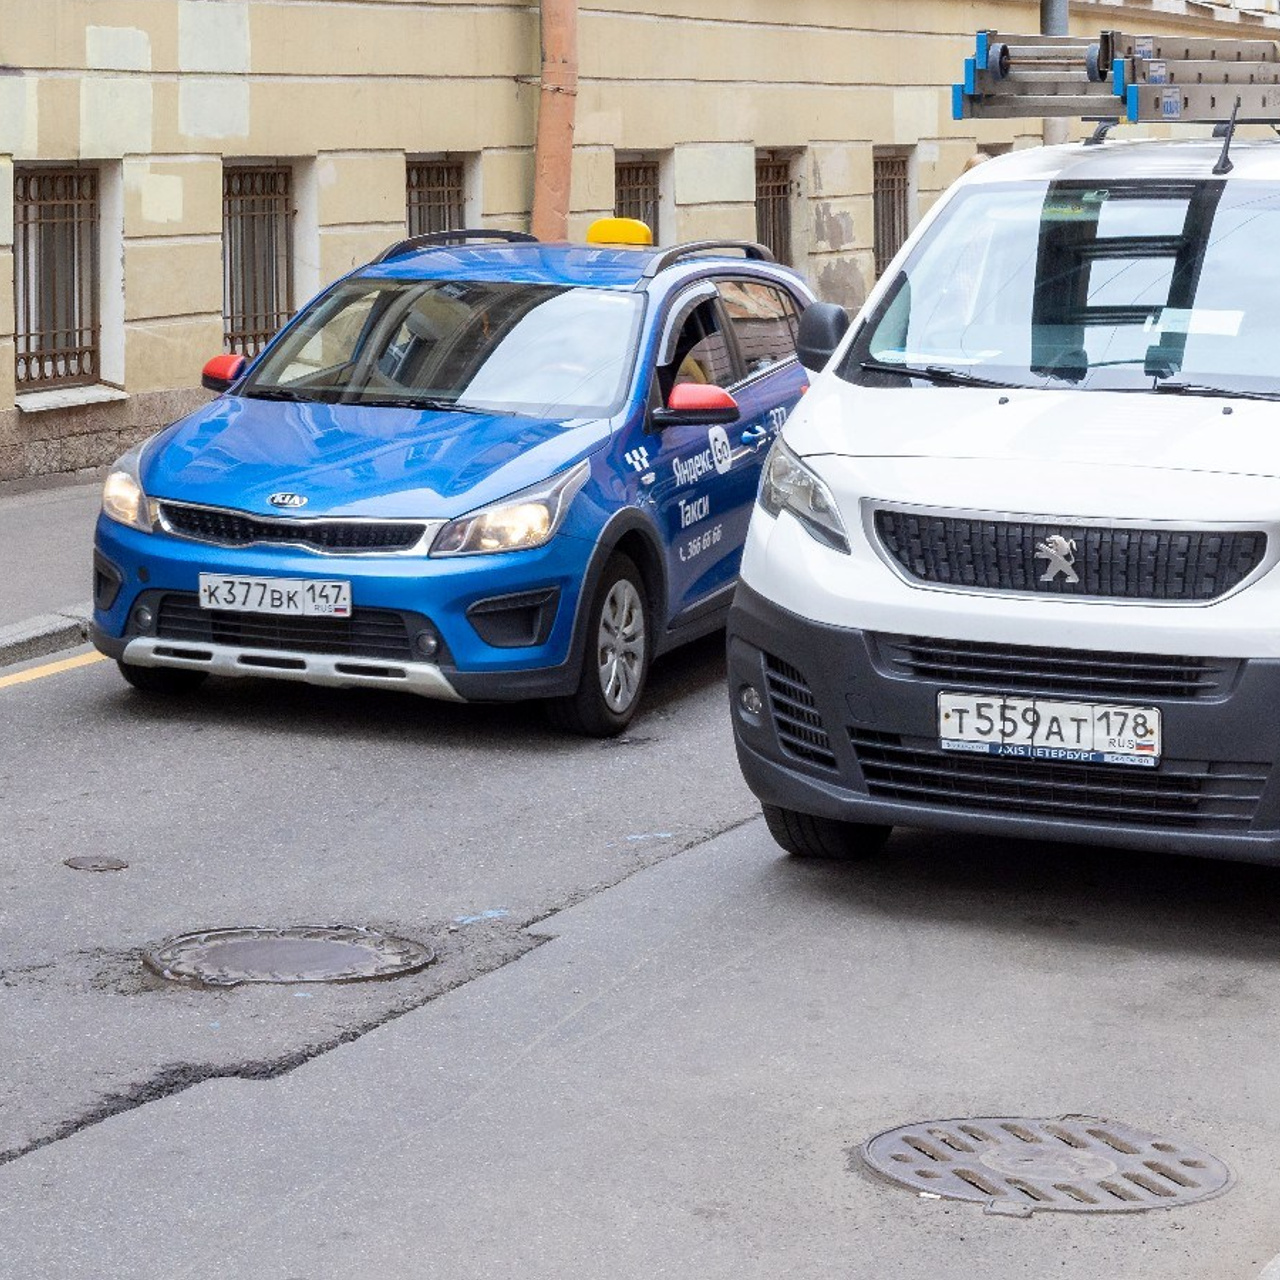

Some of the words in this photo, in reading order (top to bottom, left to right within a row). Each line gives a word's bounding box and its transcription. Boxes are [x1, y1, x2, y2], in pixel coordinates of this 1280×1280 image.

[672, 448, 714, 488] Яндекс
[272, 494, 302, 506] KIA
[678, 494, 710, 529] Такси
[306, 583, 343, 605] 147
[314, 604, 333, 614] RUS
[1096, 710, 1149, 739] 178
[1108, 737, 1135, 750] RUS
